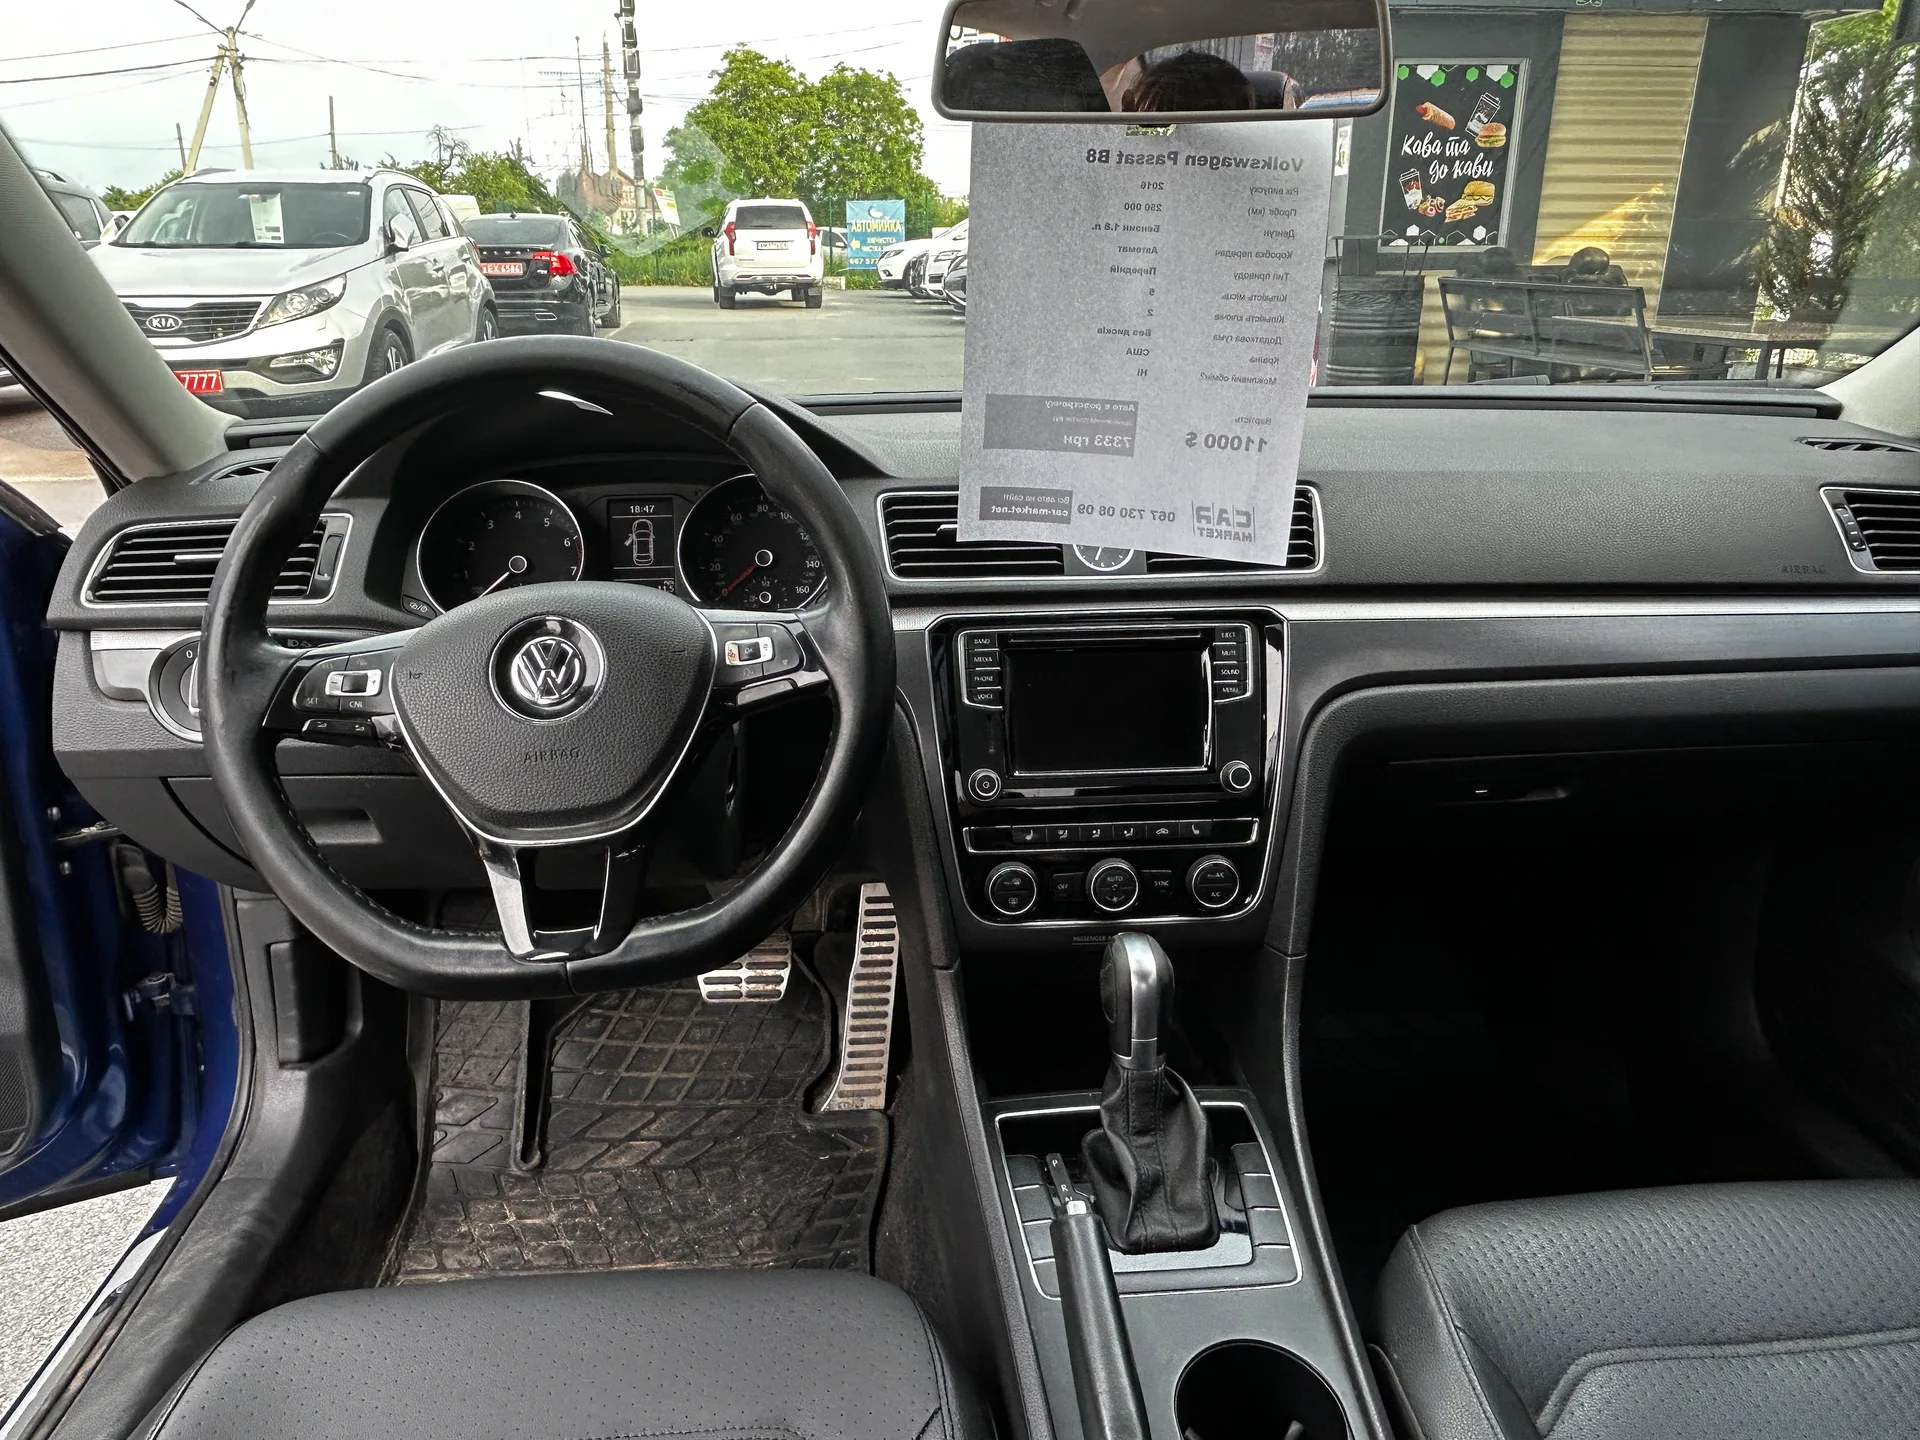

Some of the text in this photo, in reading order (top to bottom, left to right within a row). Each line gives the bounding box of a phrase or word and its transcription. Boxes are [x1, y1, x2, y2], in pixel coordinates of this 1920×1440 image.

[1401, 131, 1470, 158] Кава та
[1429, 152, 1494, 184] до кави
[851, 216, 902, 232] АВТОМИЙКА
[152, 318, 176, 327] KIA
[180, 374, 217, 389] 7777
[629, 504, 655, 514] 18:47
[757, 504, 768, 512] 80
[514, 511, 521, 519] 4
[730, 513, 742, 521] 60
[488, 520, 494, 529] 3
[544, 518, 550, 527] 5
[564, 538, 570, 546] 6
[712, 535, 723, 543] 40
[469, 542, 475, 550] 2
[709, 563, 720, 571] 20
[806, 560, 820, 568] 140
[570, 567, 577, 575] 7
[795, 586, 810, 594] 160
[349, 700, 363, 708] CNL
[523, 747, 580, 764] AIRBAG
[1052, 1159, 1058, 1167] P
[1060, 1184, 1068, 1192] R
